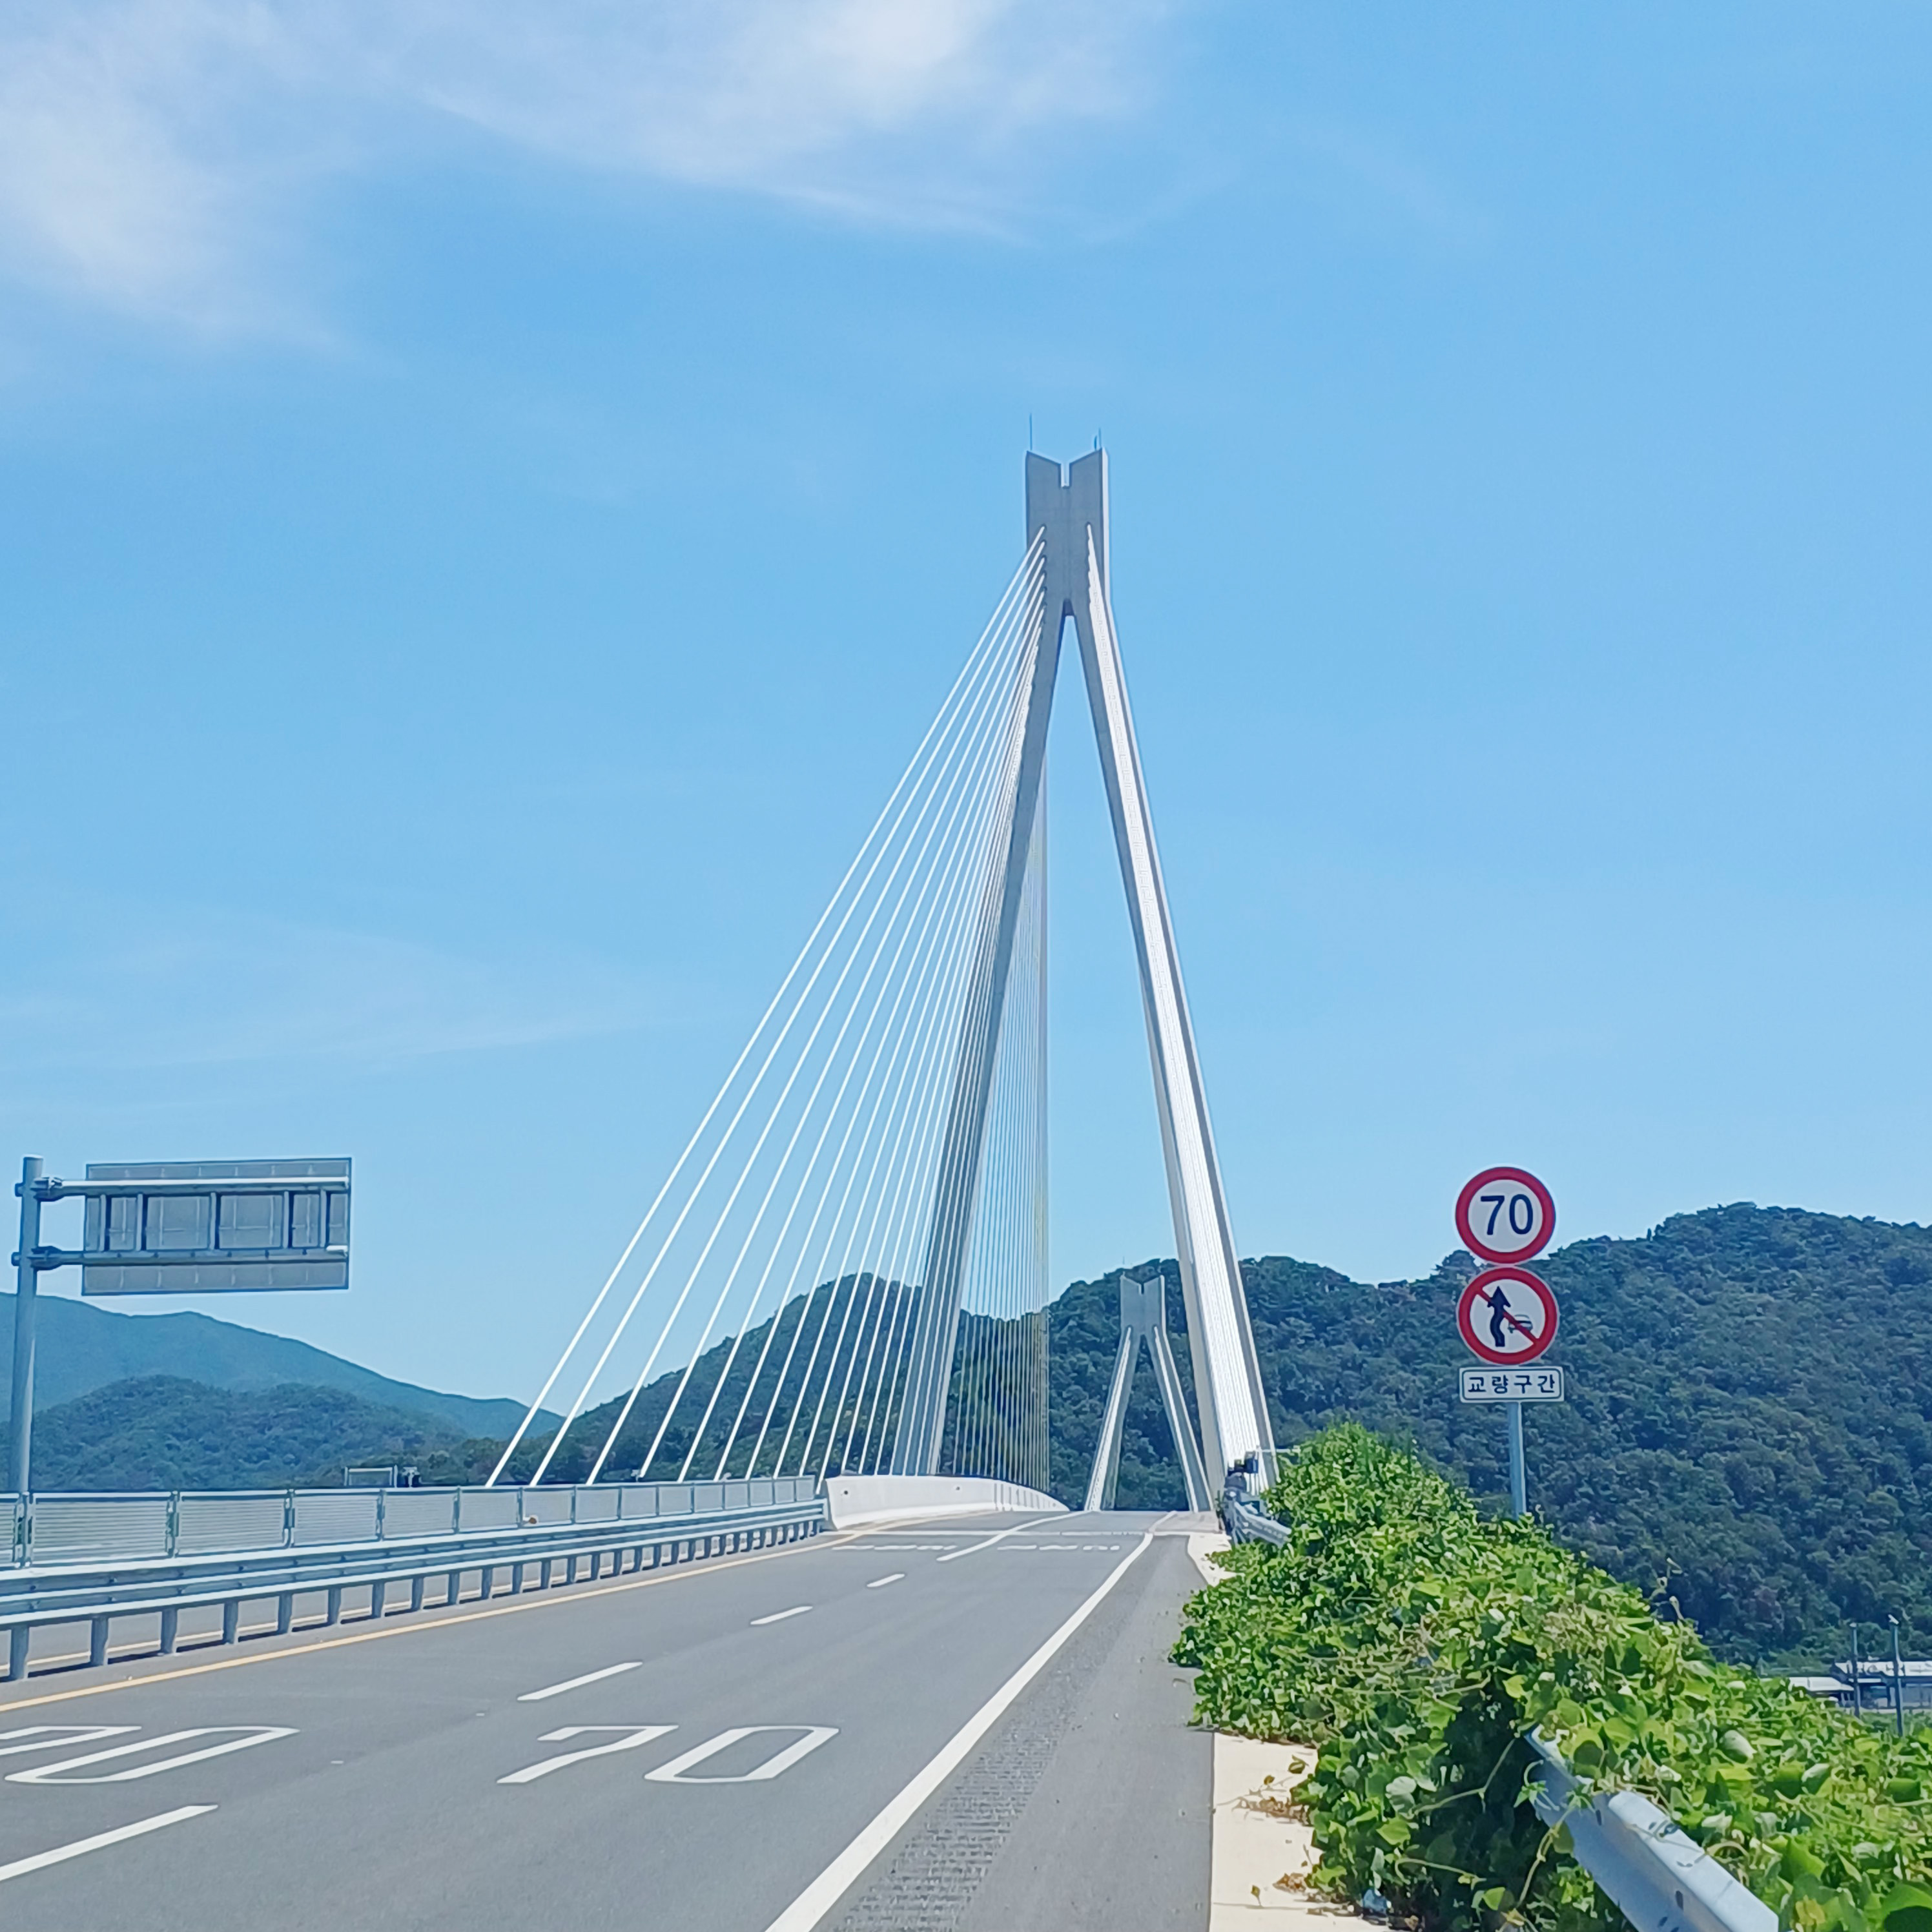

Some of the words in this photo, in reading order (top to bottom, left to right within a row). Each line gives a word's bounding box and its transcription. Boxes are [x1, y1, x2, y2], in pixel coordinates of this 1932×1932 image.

[1480, 1193, 1534, 1235] 70
[1468, 1374, 1555, 1394] 교량구간
[497, 1725, 839, 1783] 70
